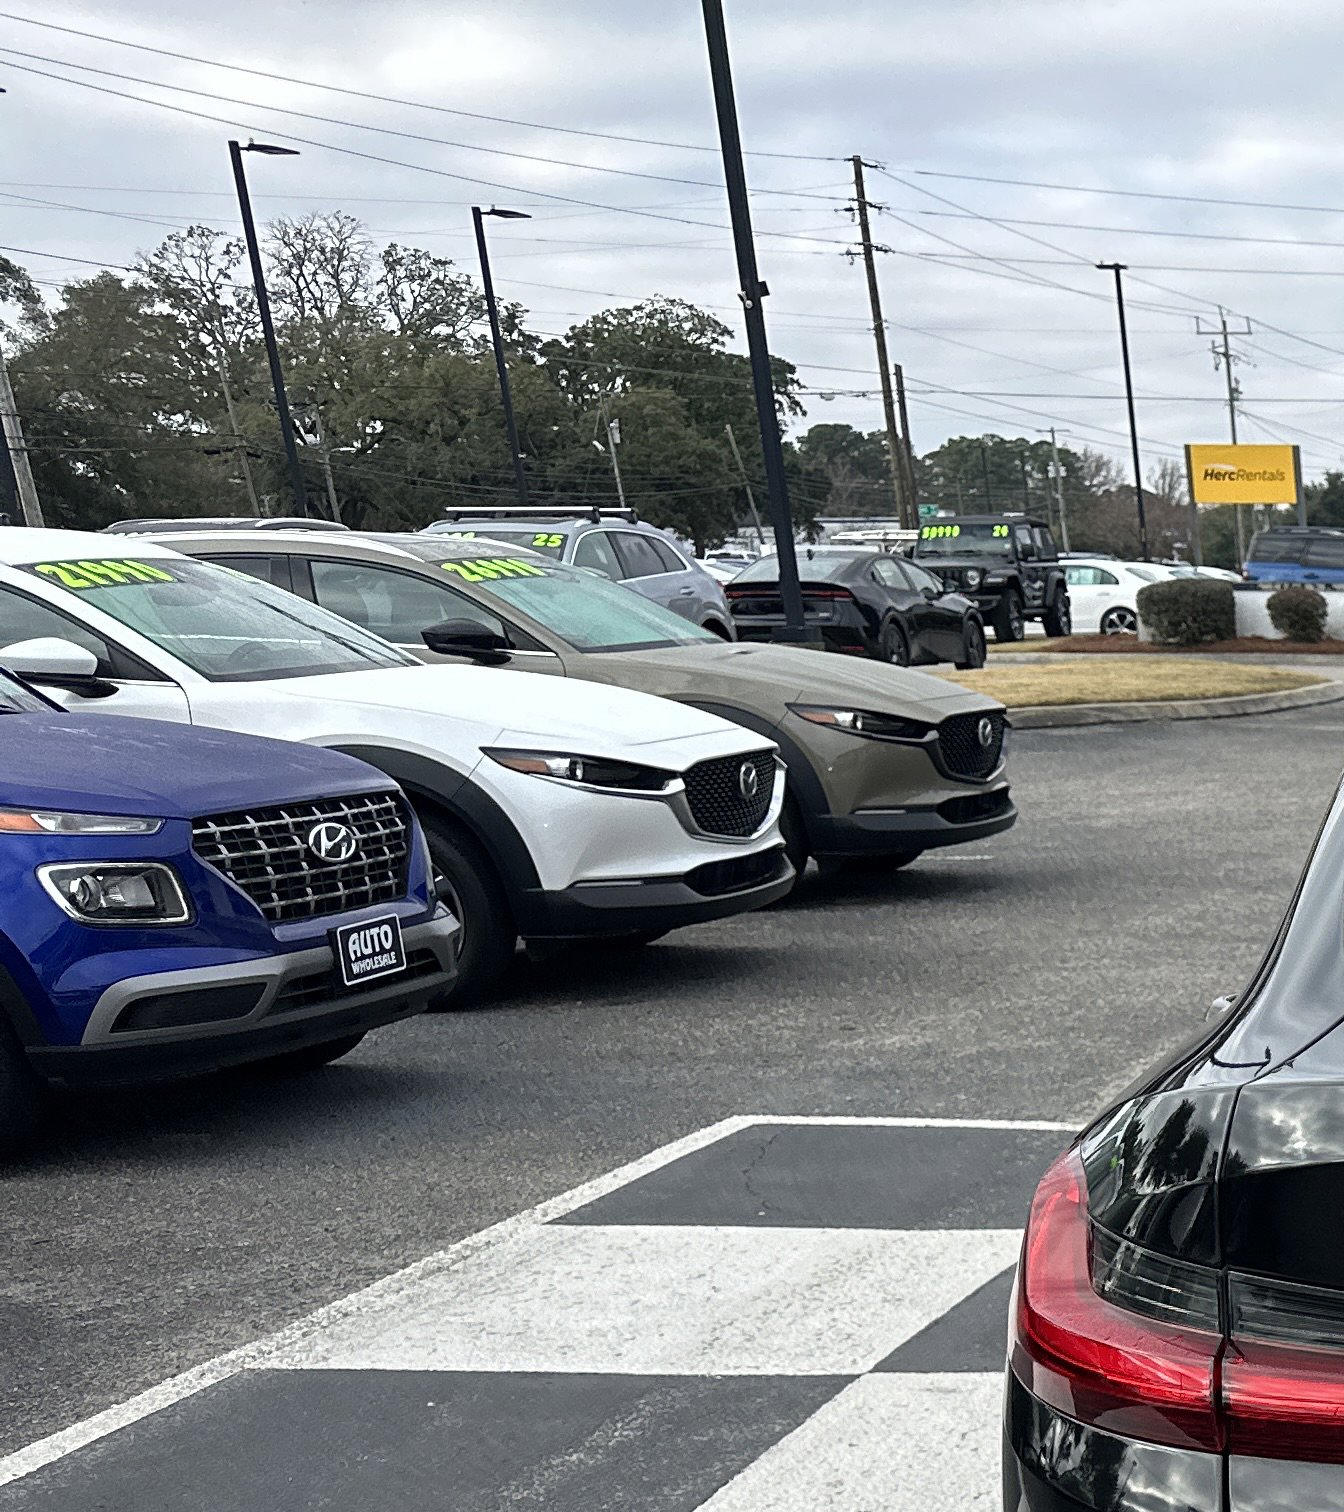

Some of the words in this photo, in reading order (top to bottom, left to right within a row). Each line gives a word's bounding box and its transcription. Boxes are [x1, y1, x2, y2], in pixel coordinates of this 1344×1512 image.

[532, 533, 564, 548] 25
[34, 559, 179, 588] 21990
[348, 924, 393, 962] AUTO
[351, 951, 397, 975] WHOLESALE
